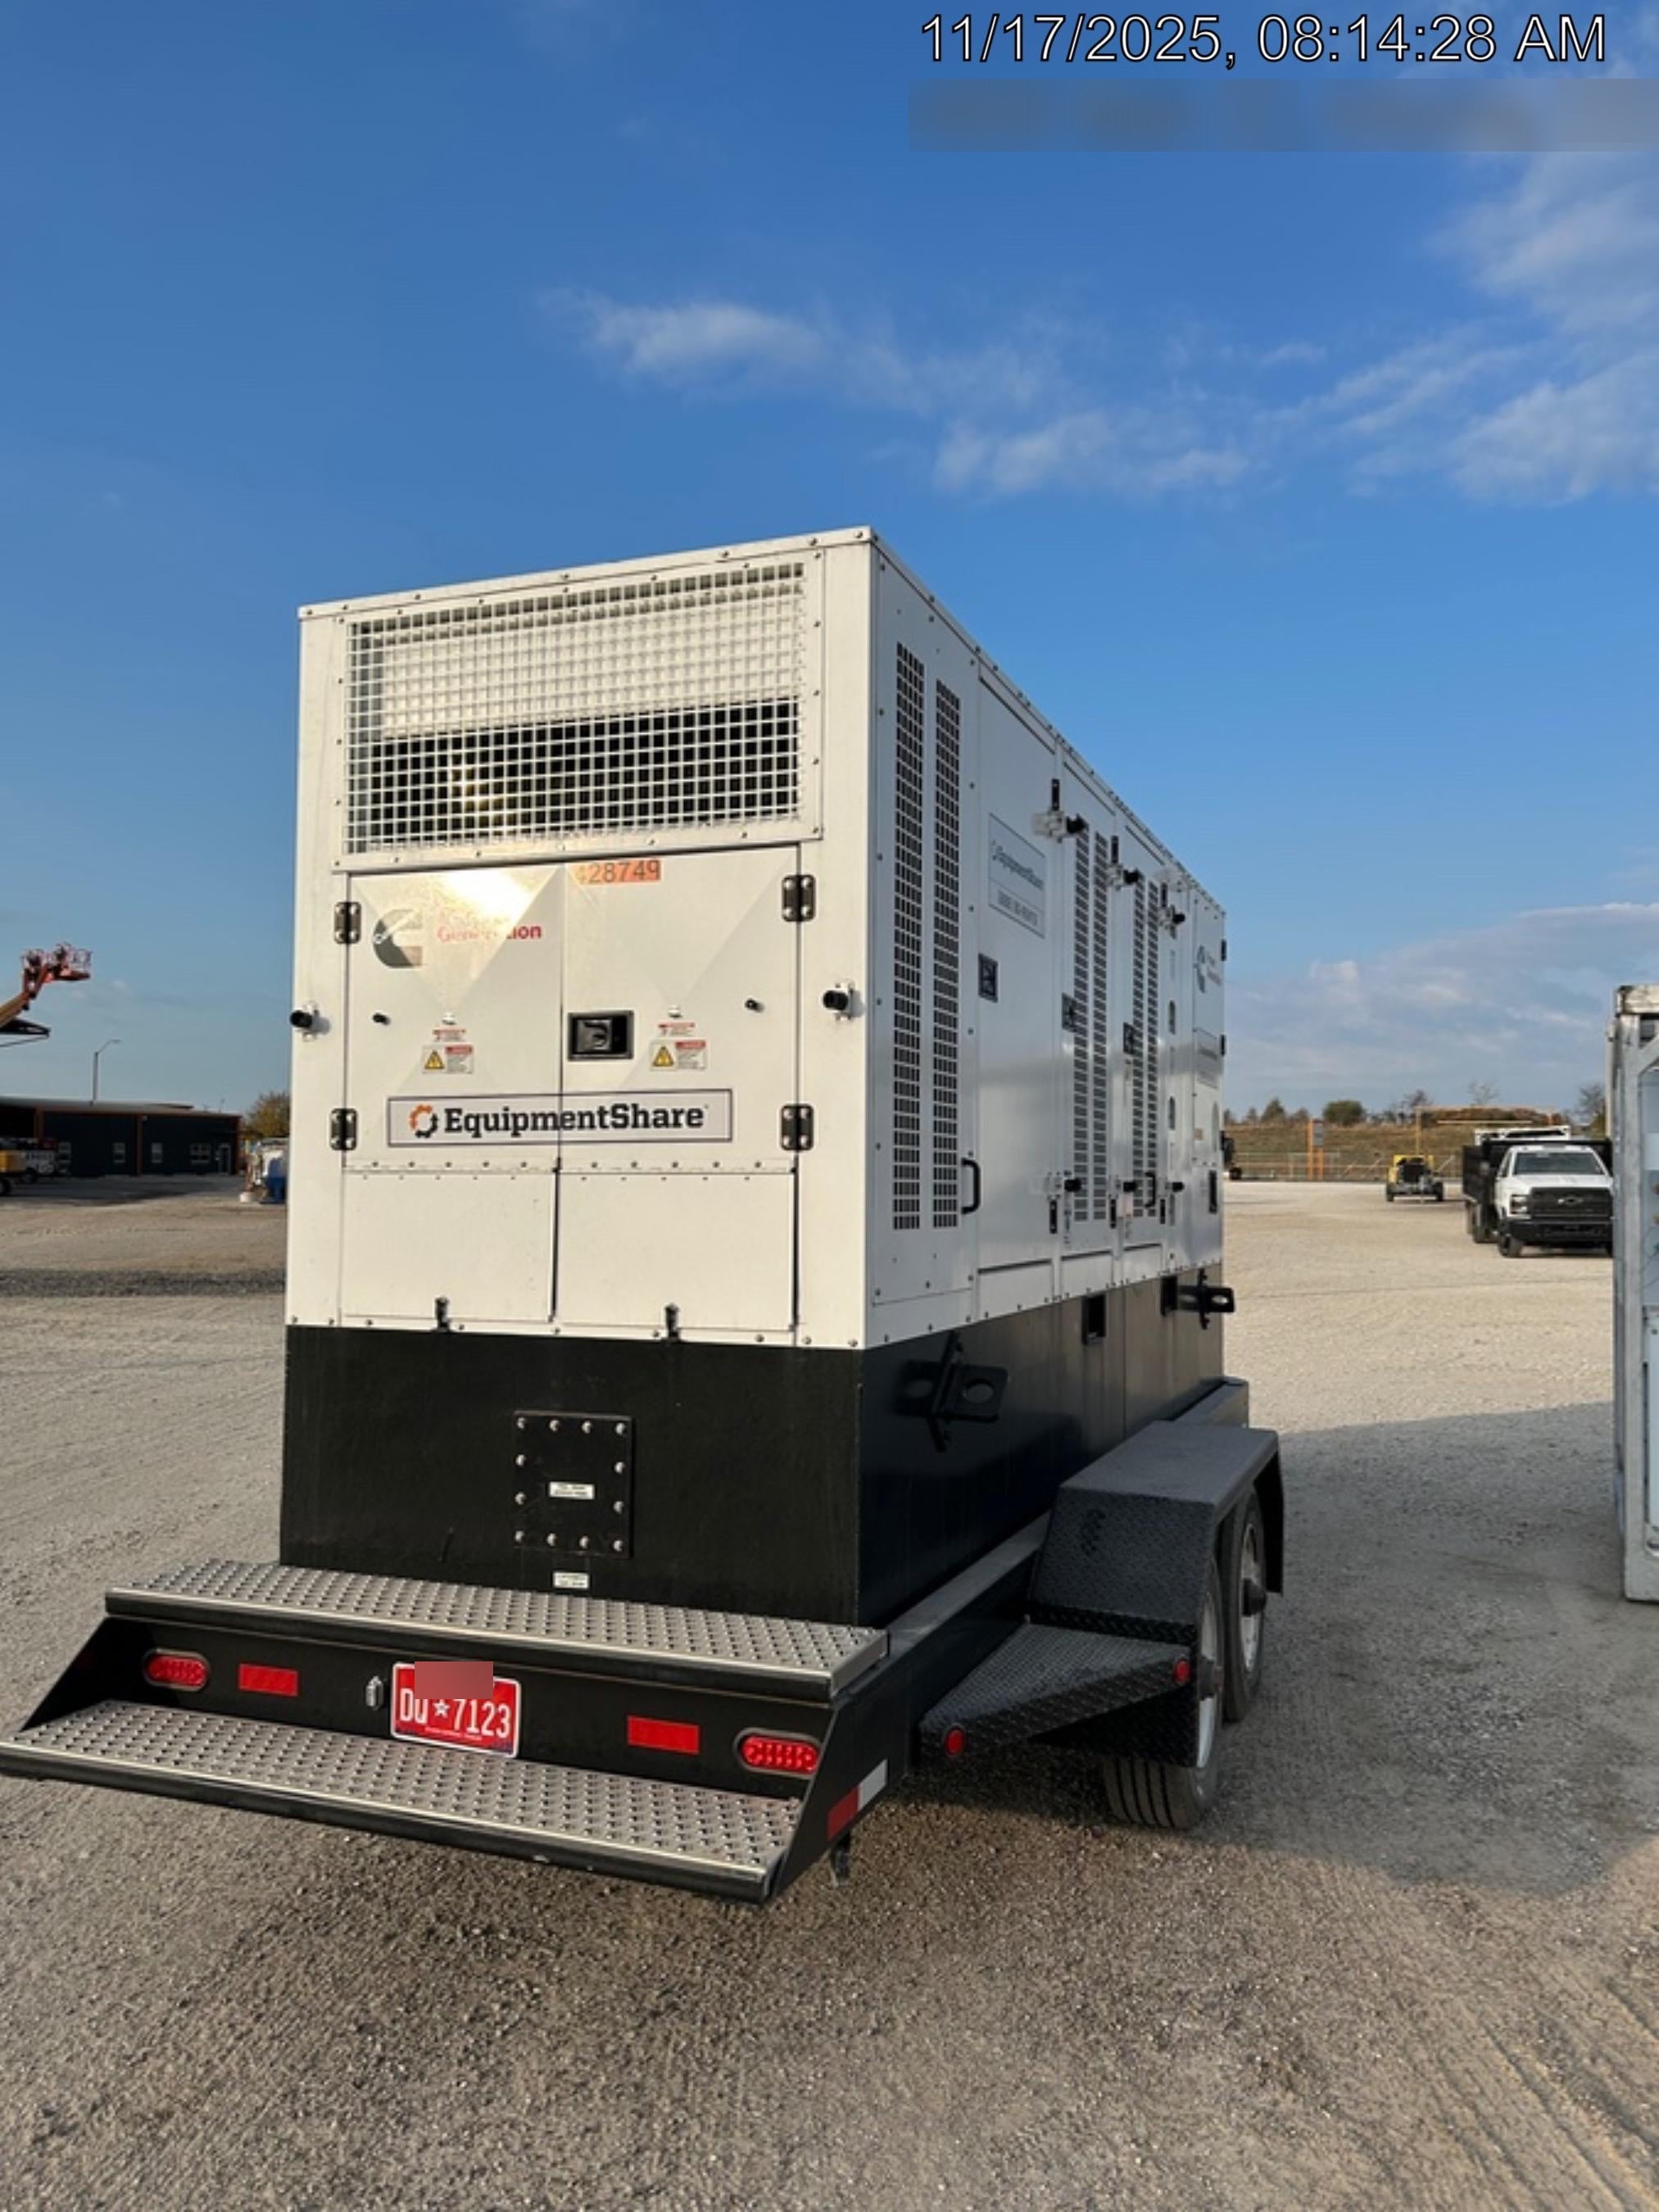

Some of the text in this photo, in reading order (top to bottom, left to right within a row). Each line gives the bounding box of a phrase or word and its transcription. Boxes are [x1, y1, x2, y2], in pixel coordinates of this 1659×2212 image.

[574, 859, 661, 884] 428749
[443, 1103, 704, 1139] EquipmentShare
[453, 1698, 511, 1738] 7123
